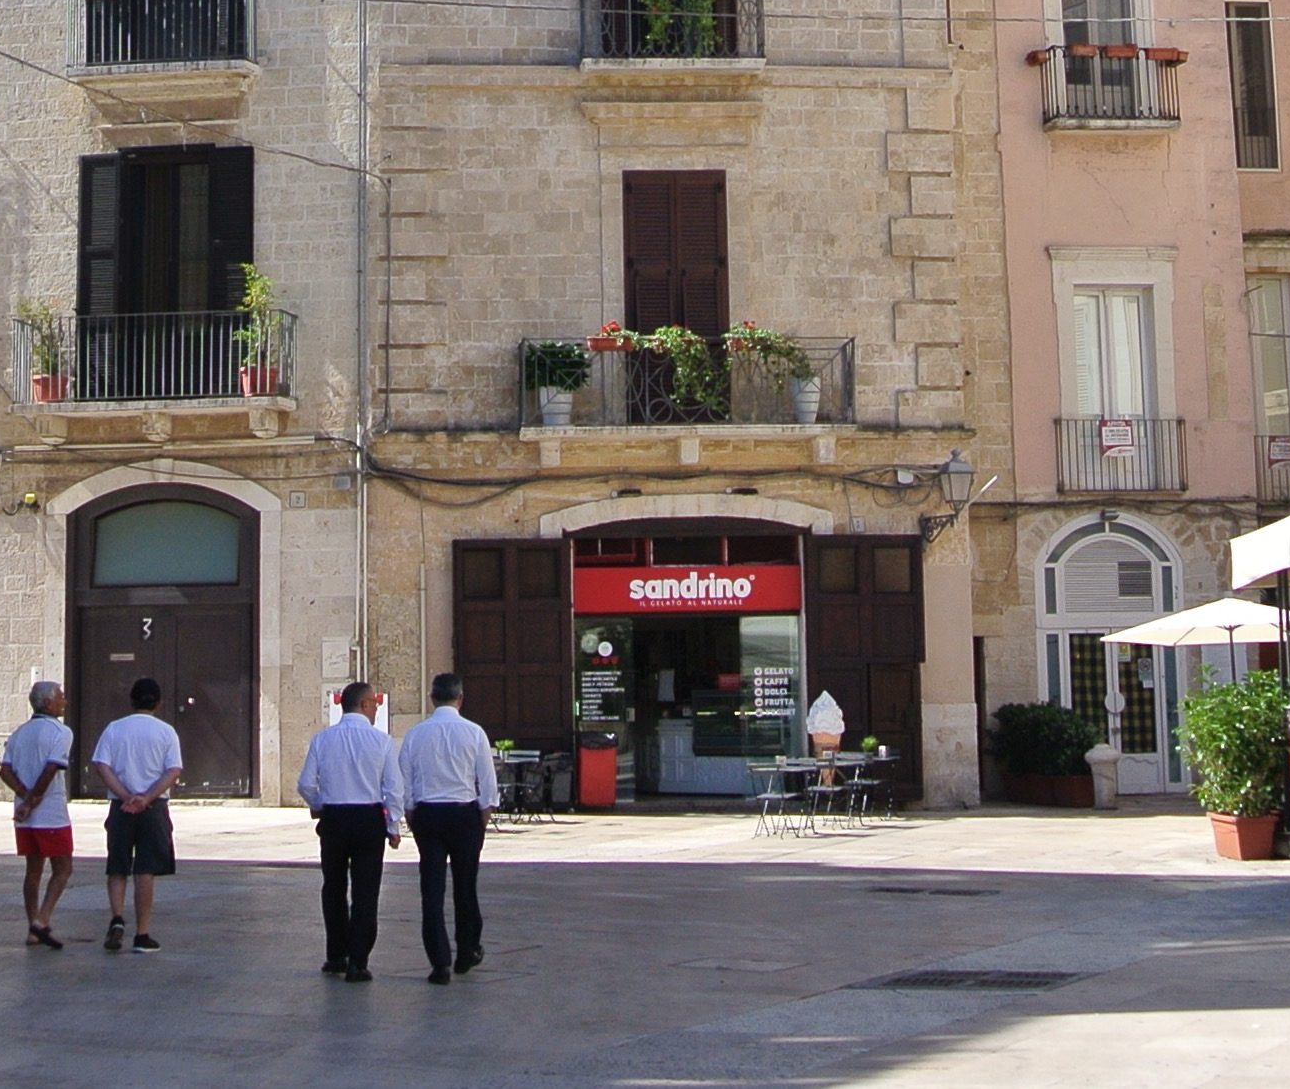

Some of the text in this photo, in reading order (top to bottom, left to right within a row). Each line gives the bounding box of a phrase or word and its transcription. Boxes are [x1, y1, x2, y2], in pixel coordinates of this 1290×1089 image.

[629, 571, 752, 599] sandrino
[701, 598, 743, 606] NATURALE
[142, 617, 152, 640] 3
[764, 667, 794, 676] GELATO
[764, 688, 788, 696] DOLCI
[764, 698, 795, 706] FRUTTA
